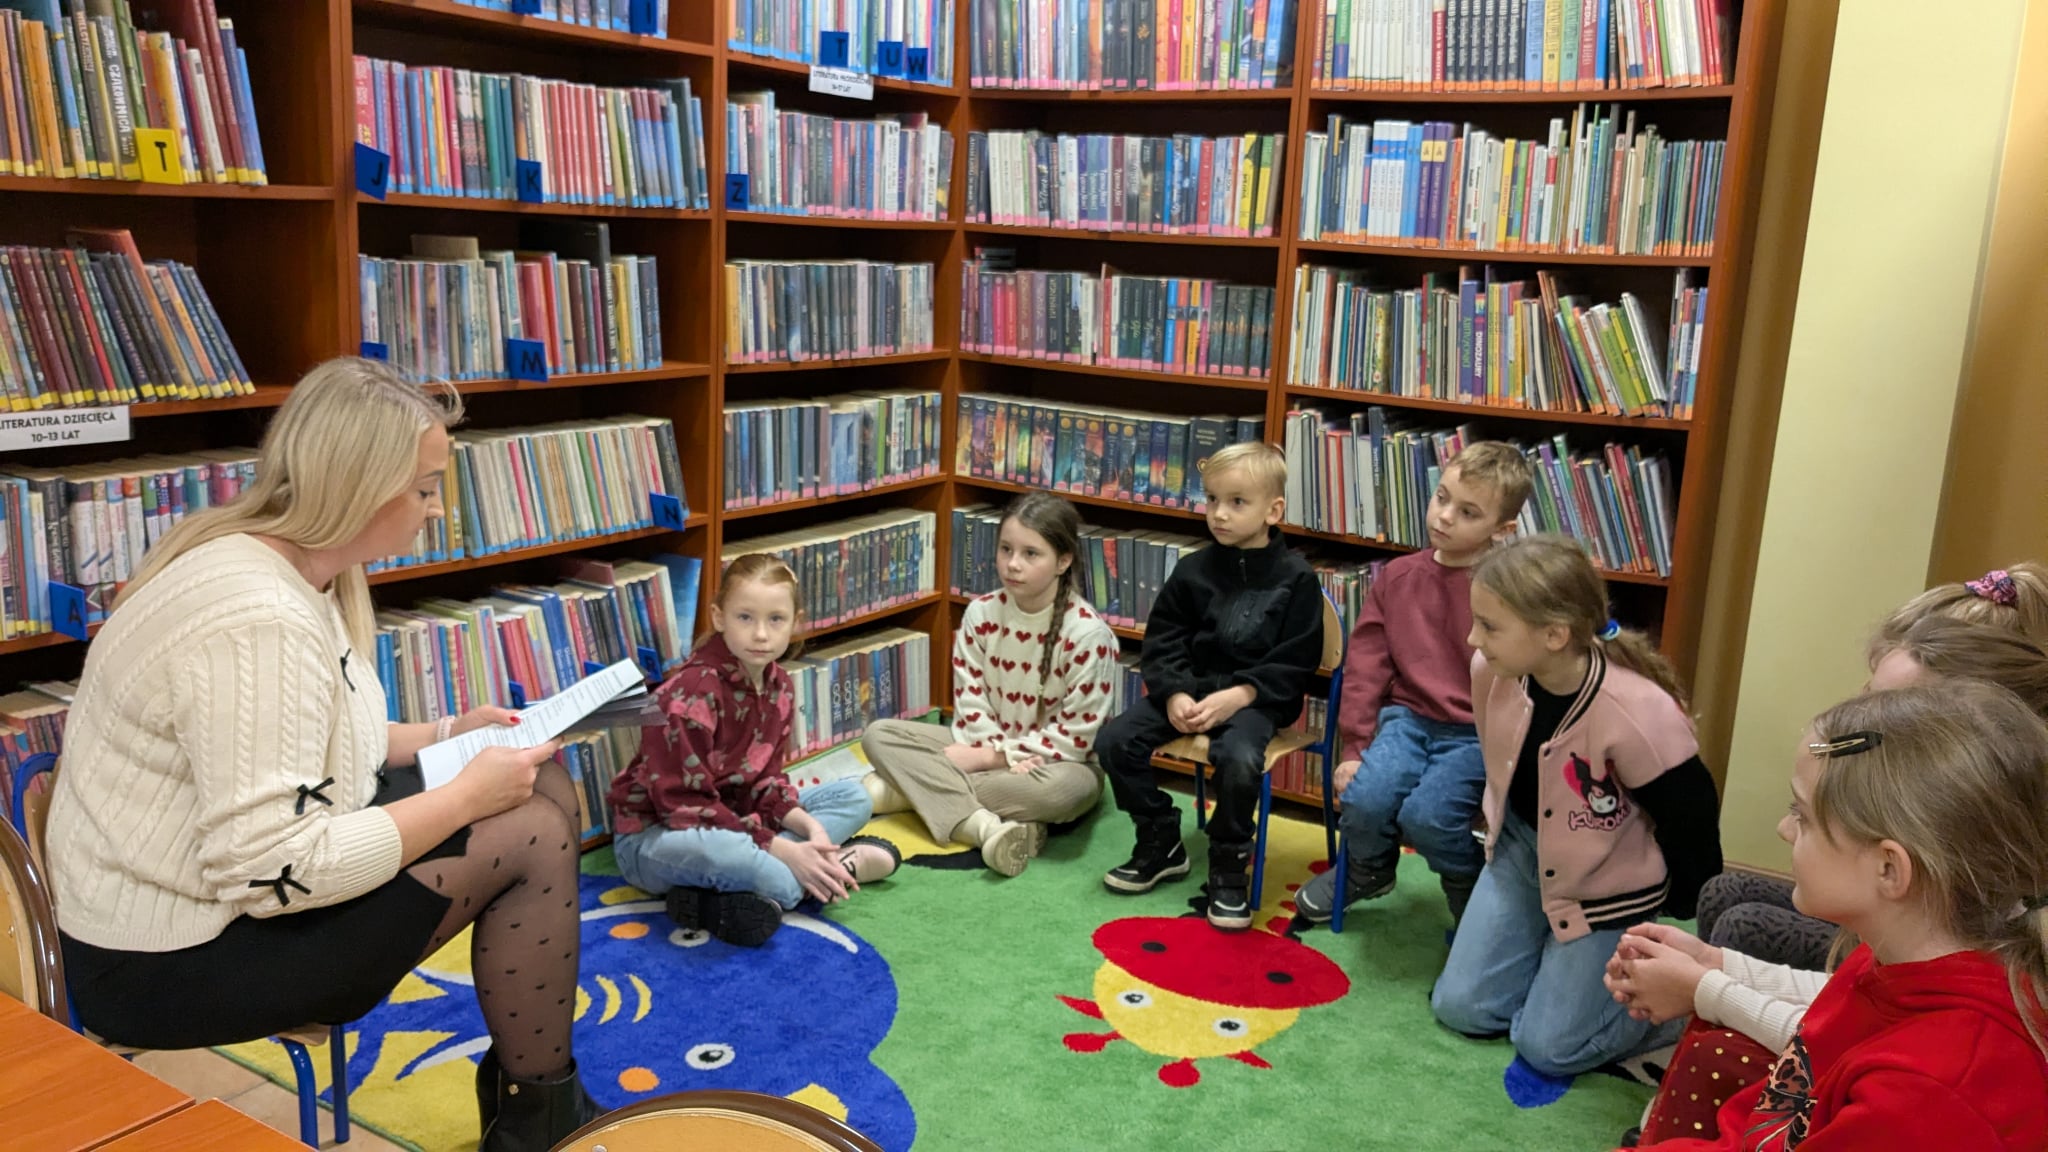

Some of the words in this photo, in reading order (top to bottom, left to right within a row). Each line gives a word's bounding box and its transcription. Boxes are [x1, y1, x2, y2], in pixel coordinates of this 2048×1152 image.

[836, 38, 846, 59] T
[886, 47, 898, 67] U
[908, 55, 926, 76] W
[154, 140, 168, 172] T
[370, 162, 384, 186] J
[526, 166, 541, 194] K
[731, 182, 744, 203] Z
[521, 350, 546, 376] M
[1474, 331, 1484, 379] DINOZAURY
[63, 411, 116, 425] DZIECIĘCA
[31, 432, 58, 443] 10-13
[61, 430, 80, 440] LAT
[664, 503, 680, 524] N
[69, 597, 84, 625] A
